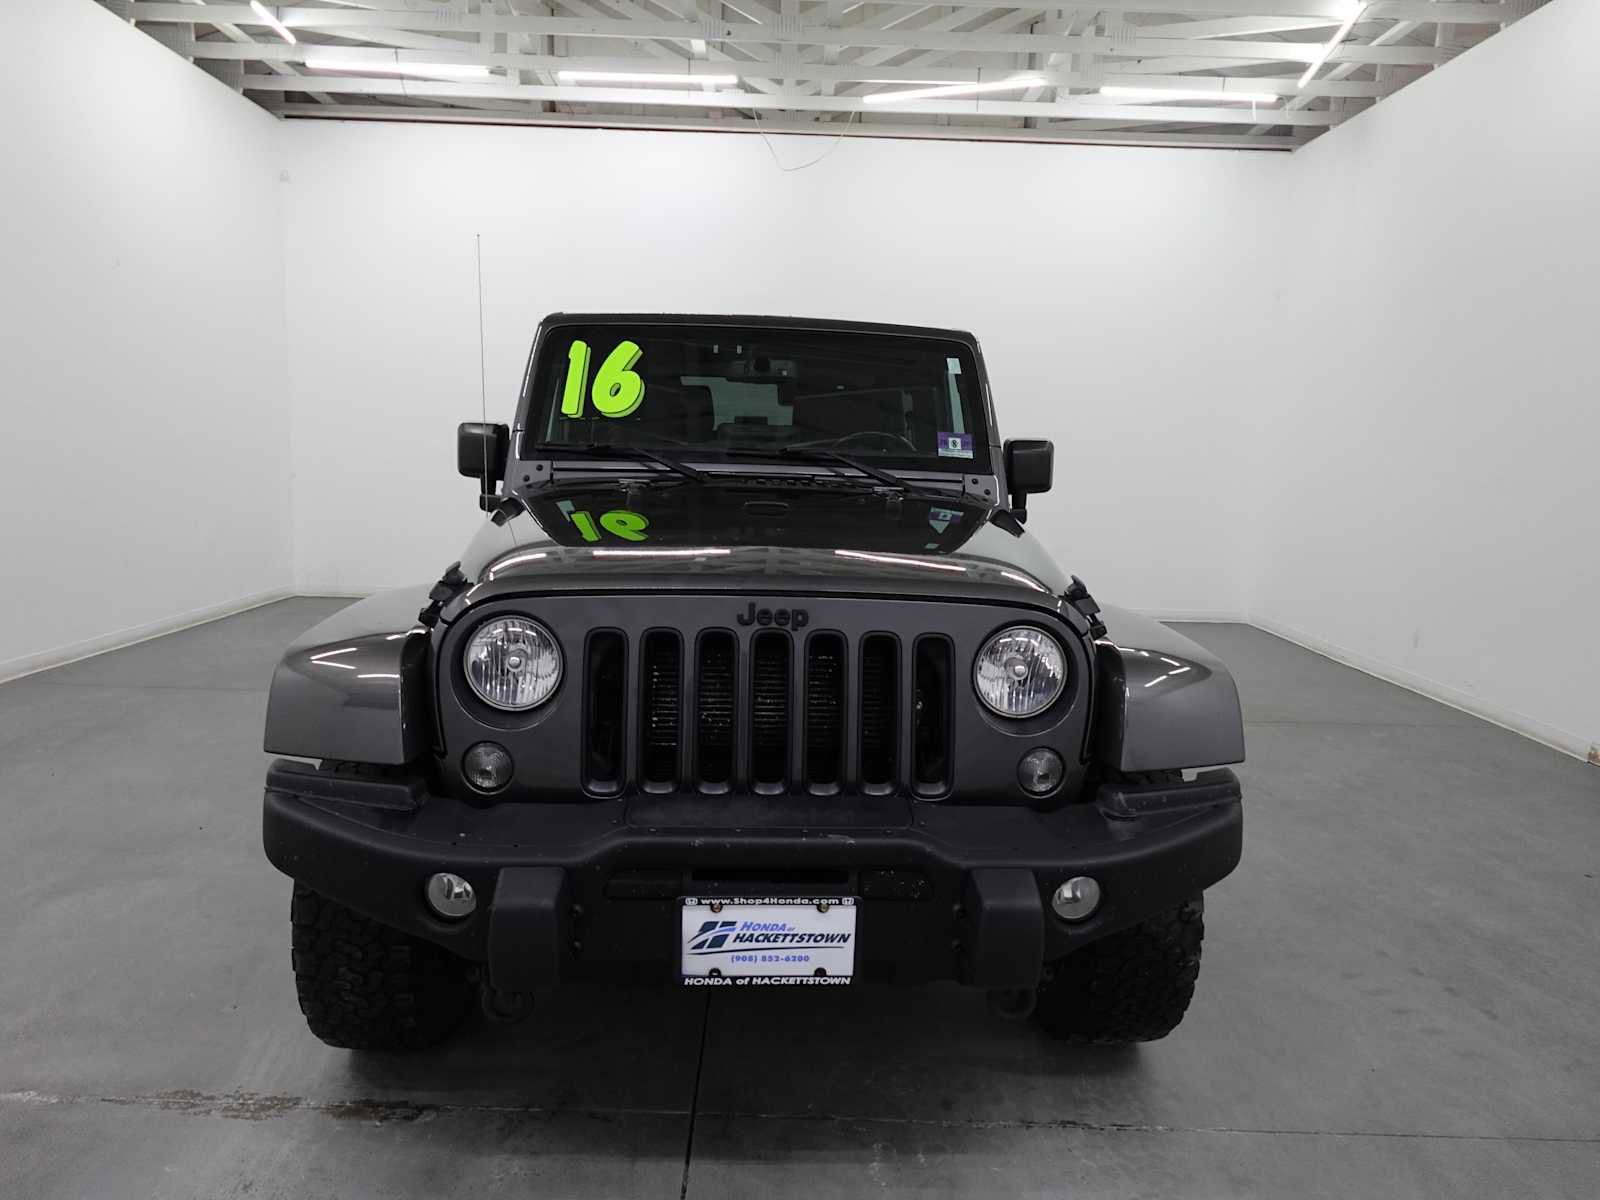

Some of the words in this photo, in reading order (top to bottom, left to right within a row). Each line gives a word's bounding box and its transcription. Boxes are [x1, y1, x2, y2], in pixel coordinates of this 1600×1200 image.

[561, 339, 646, 419] 16
[736, 602, 809, 631] Jeep
[701, 898, 840, 906] www.Shop4Honda.com
[740, 921, 786, 932] HONDA
[732, 933, 851, 943] HACKETTSTOWN
[731, 955, 758, 964] (908)
[684, 977, 733, 986] HONDA
[735, 977, 750, 986] of
[752, 976, 851, 985] HACKETTSTOWN
